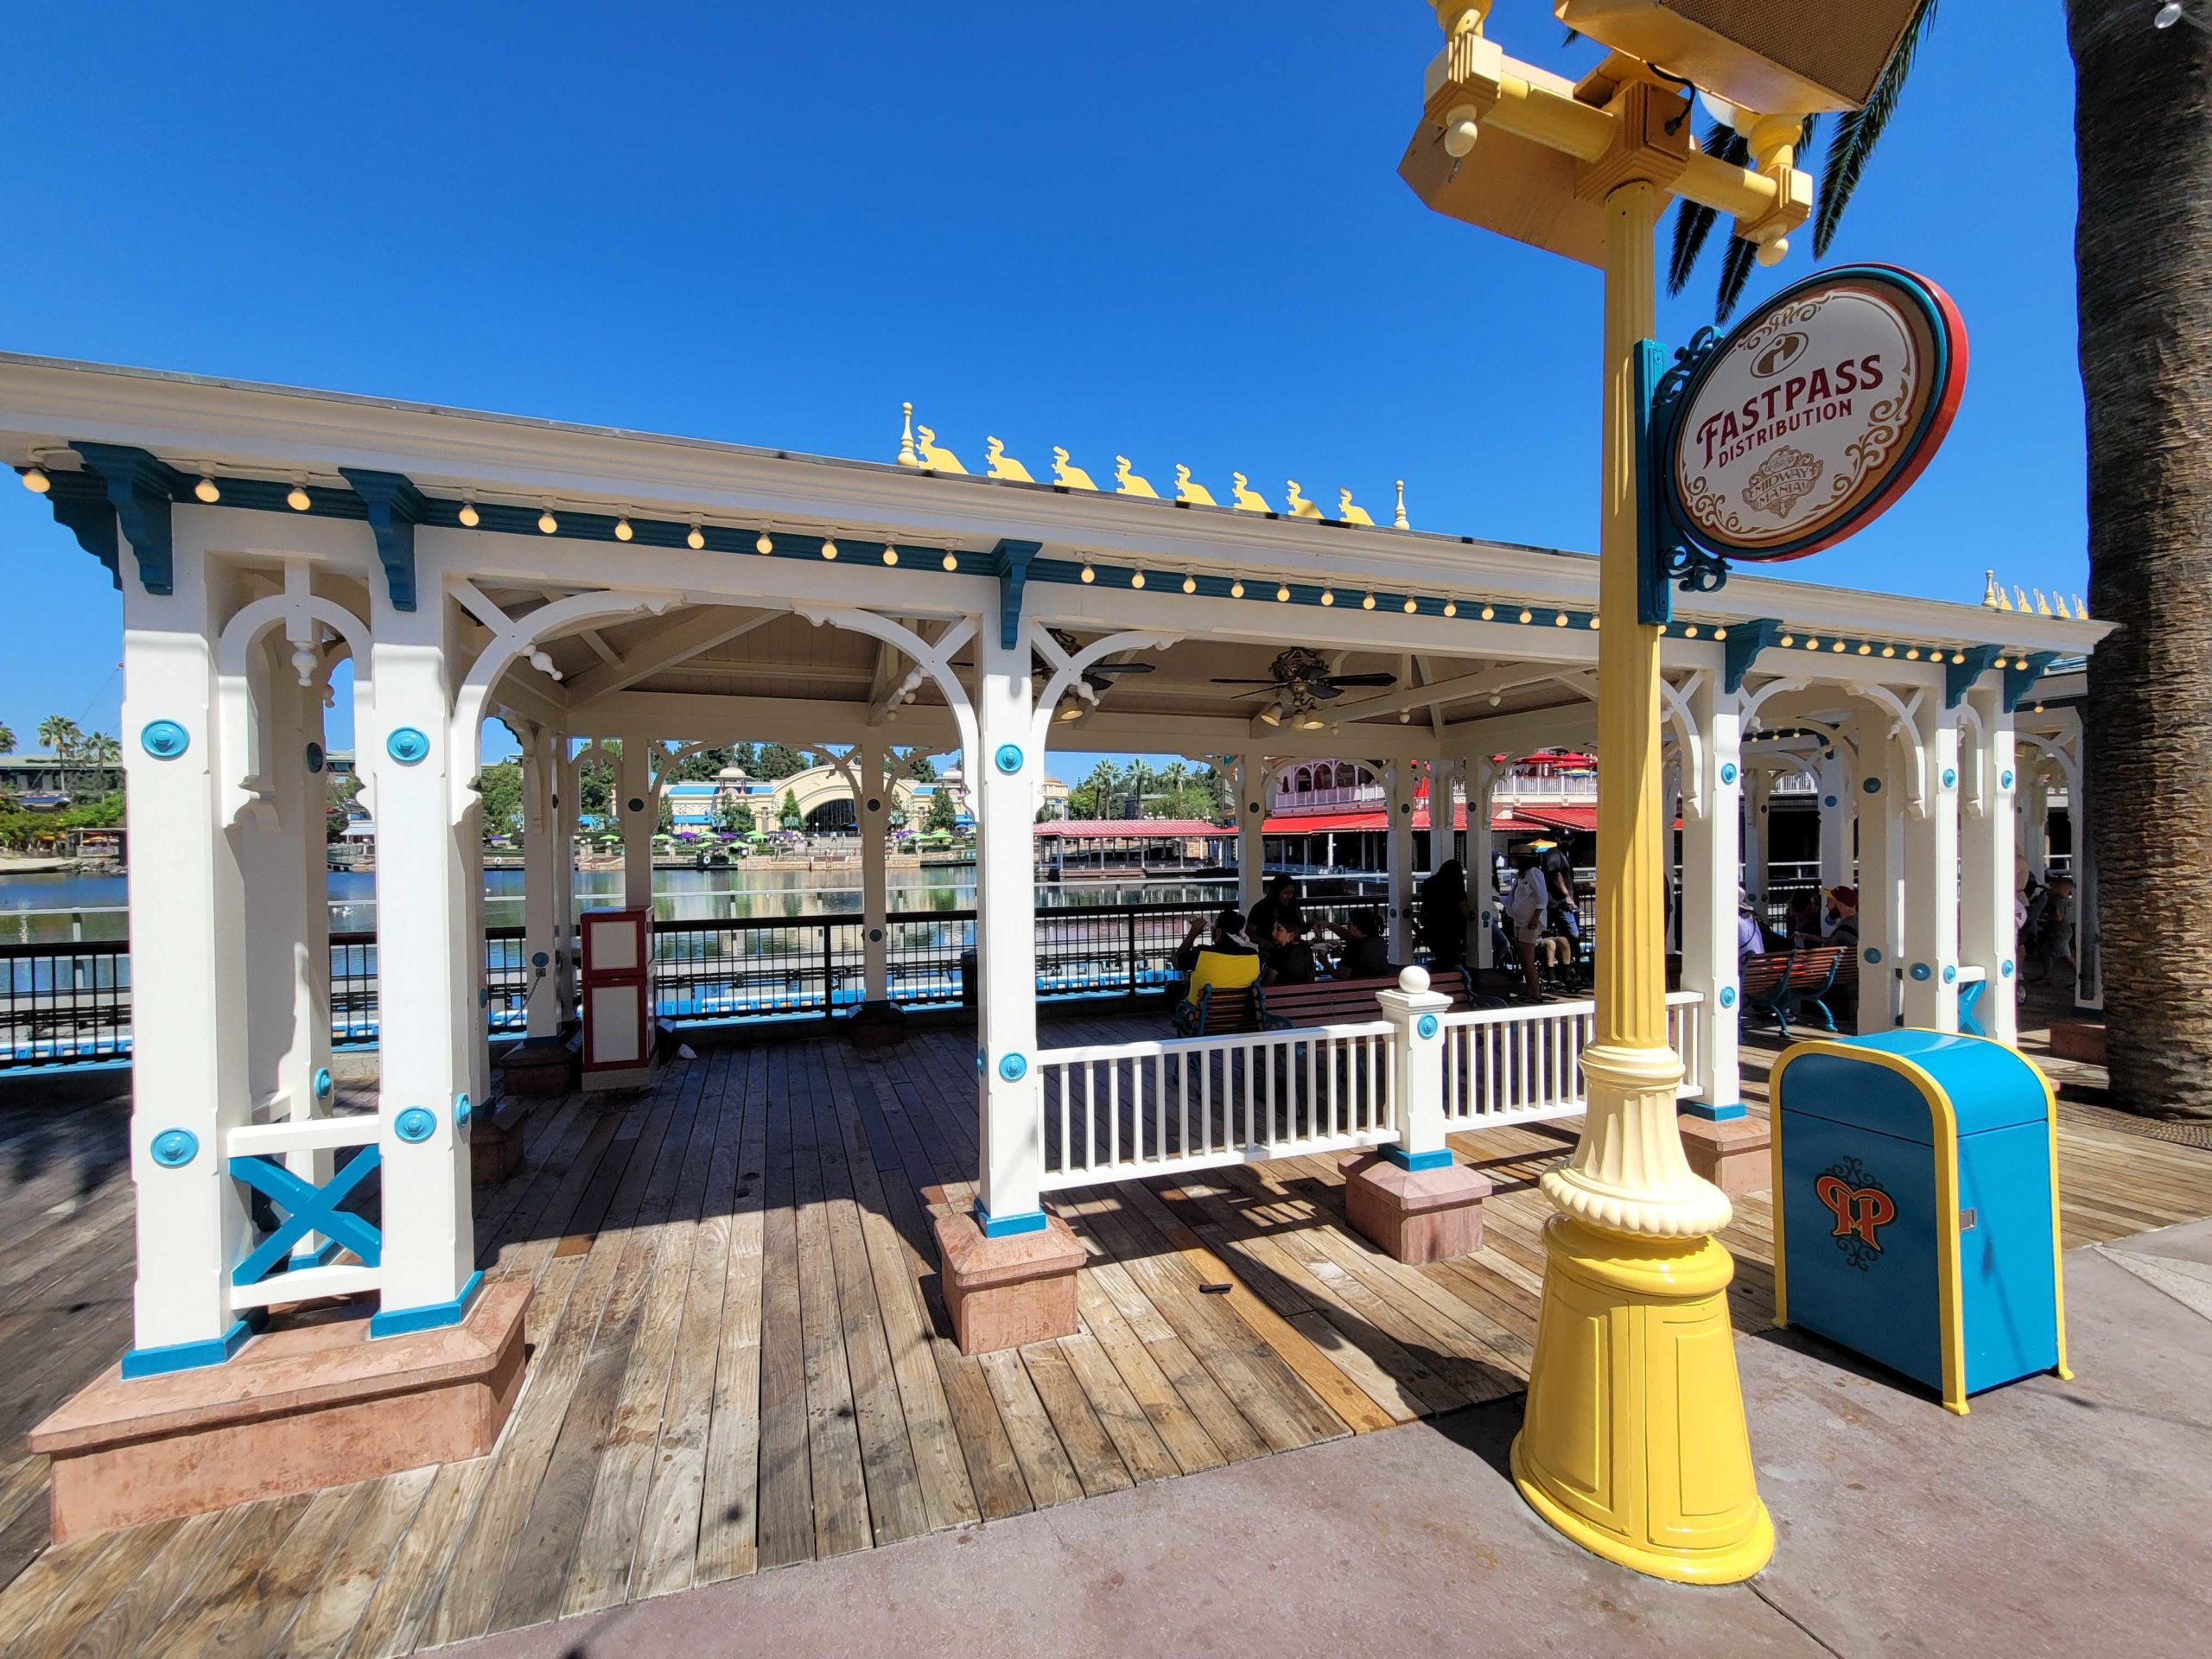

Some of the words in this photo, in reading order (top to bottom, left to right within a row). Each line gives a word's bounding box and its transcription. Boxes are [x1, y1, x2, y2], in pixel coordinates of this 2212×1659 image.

[1696, 354, 1884, 469] FASTPASS
[1719, 399, 1853, 468] DISTRIBUTION
[1754, 467, 1809, 495] MIDWAY
